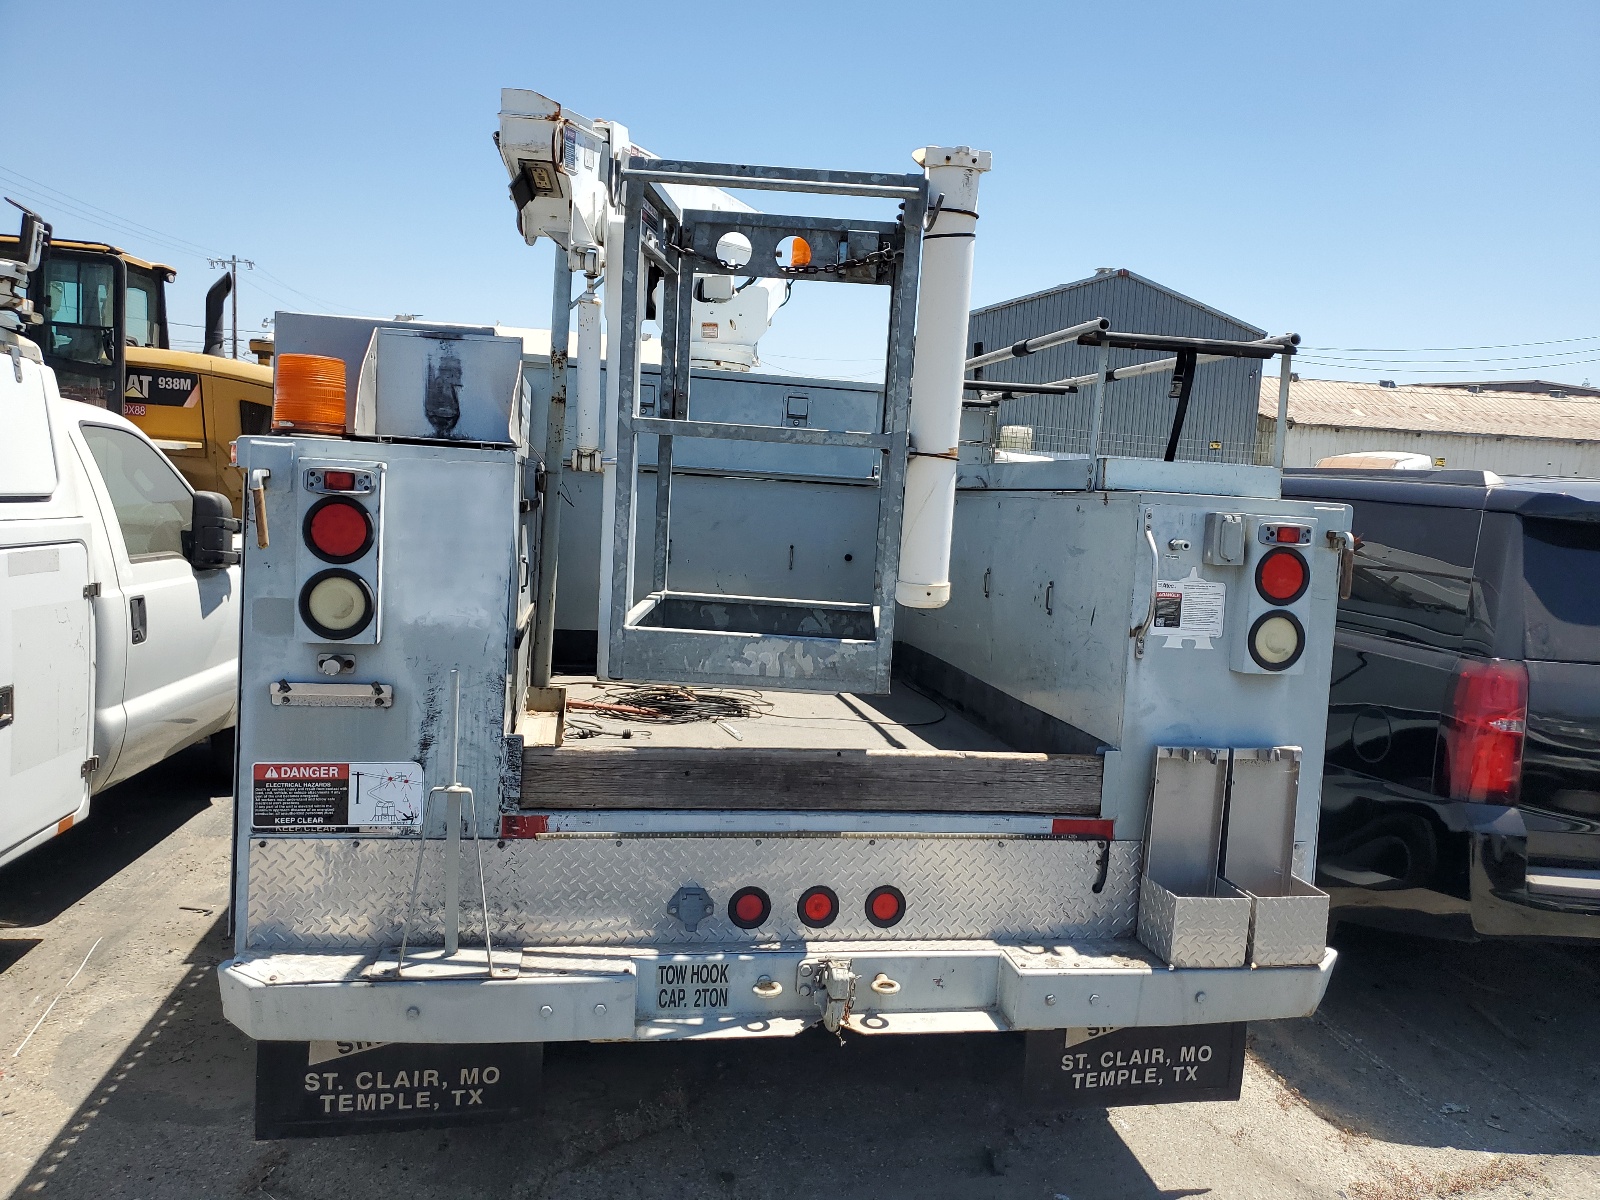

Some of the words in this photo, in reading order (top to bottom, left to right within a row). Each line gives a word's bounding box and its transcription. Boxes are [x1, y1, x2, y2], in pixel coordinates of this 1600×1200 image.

[126, 374, 153, 399] AT
[158, 377, 192, 391] 938M
[280, 766, 339, 778] DANGER
[658, 964, 688, 985] TOW
[690, 963, 730, 984] HOOK
[658, 988, 687, 1009] CAP.
[693, 987, 728, 1008] 2TON
[1060, 1053, 1091, 1071] ST.
[1100, 1047, 1171, 1068] CLAIR,
[1179, 1045, 1213, 1062] MO
[304, 1072, 344, 1092] ST.
[355, 1069, 448, 1090] CLAIR,
[460, 1066, 500, 1085] MO
[1071, 1067, 1163, 1089] TEMPLE,
[1172, 1065, 1199, 1082] TX
[319, 1091, 440, 1113] TEMPLE,
[451, 1088, 484, 1106] TX
